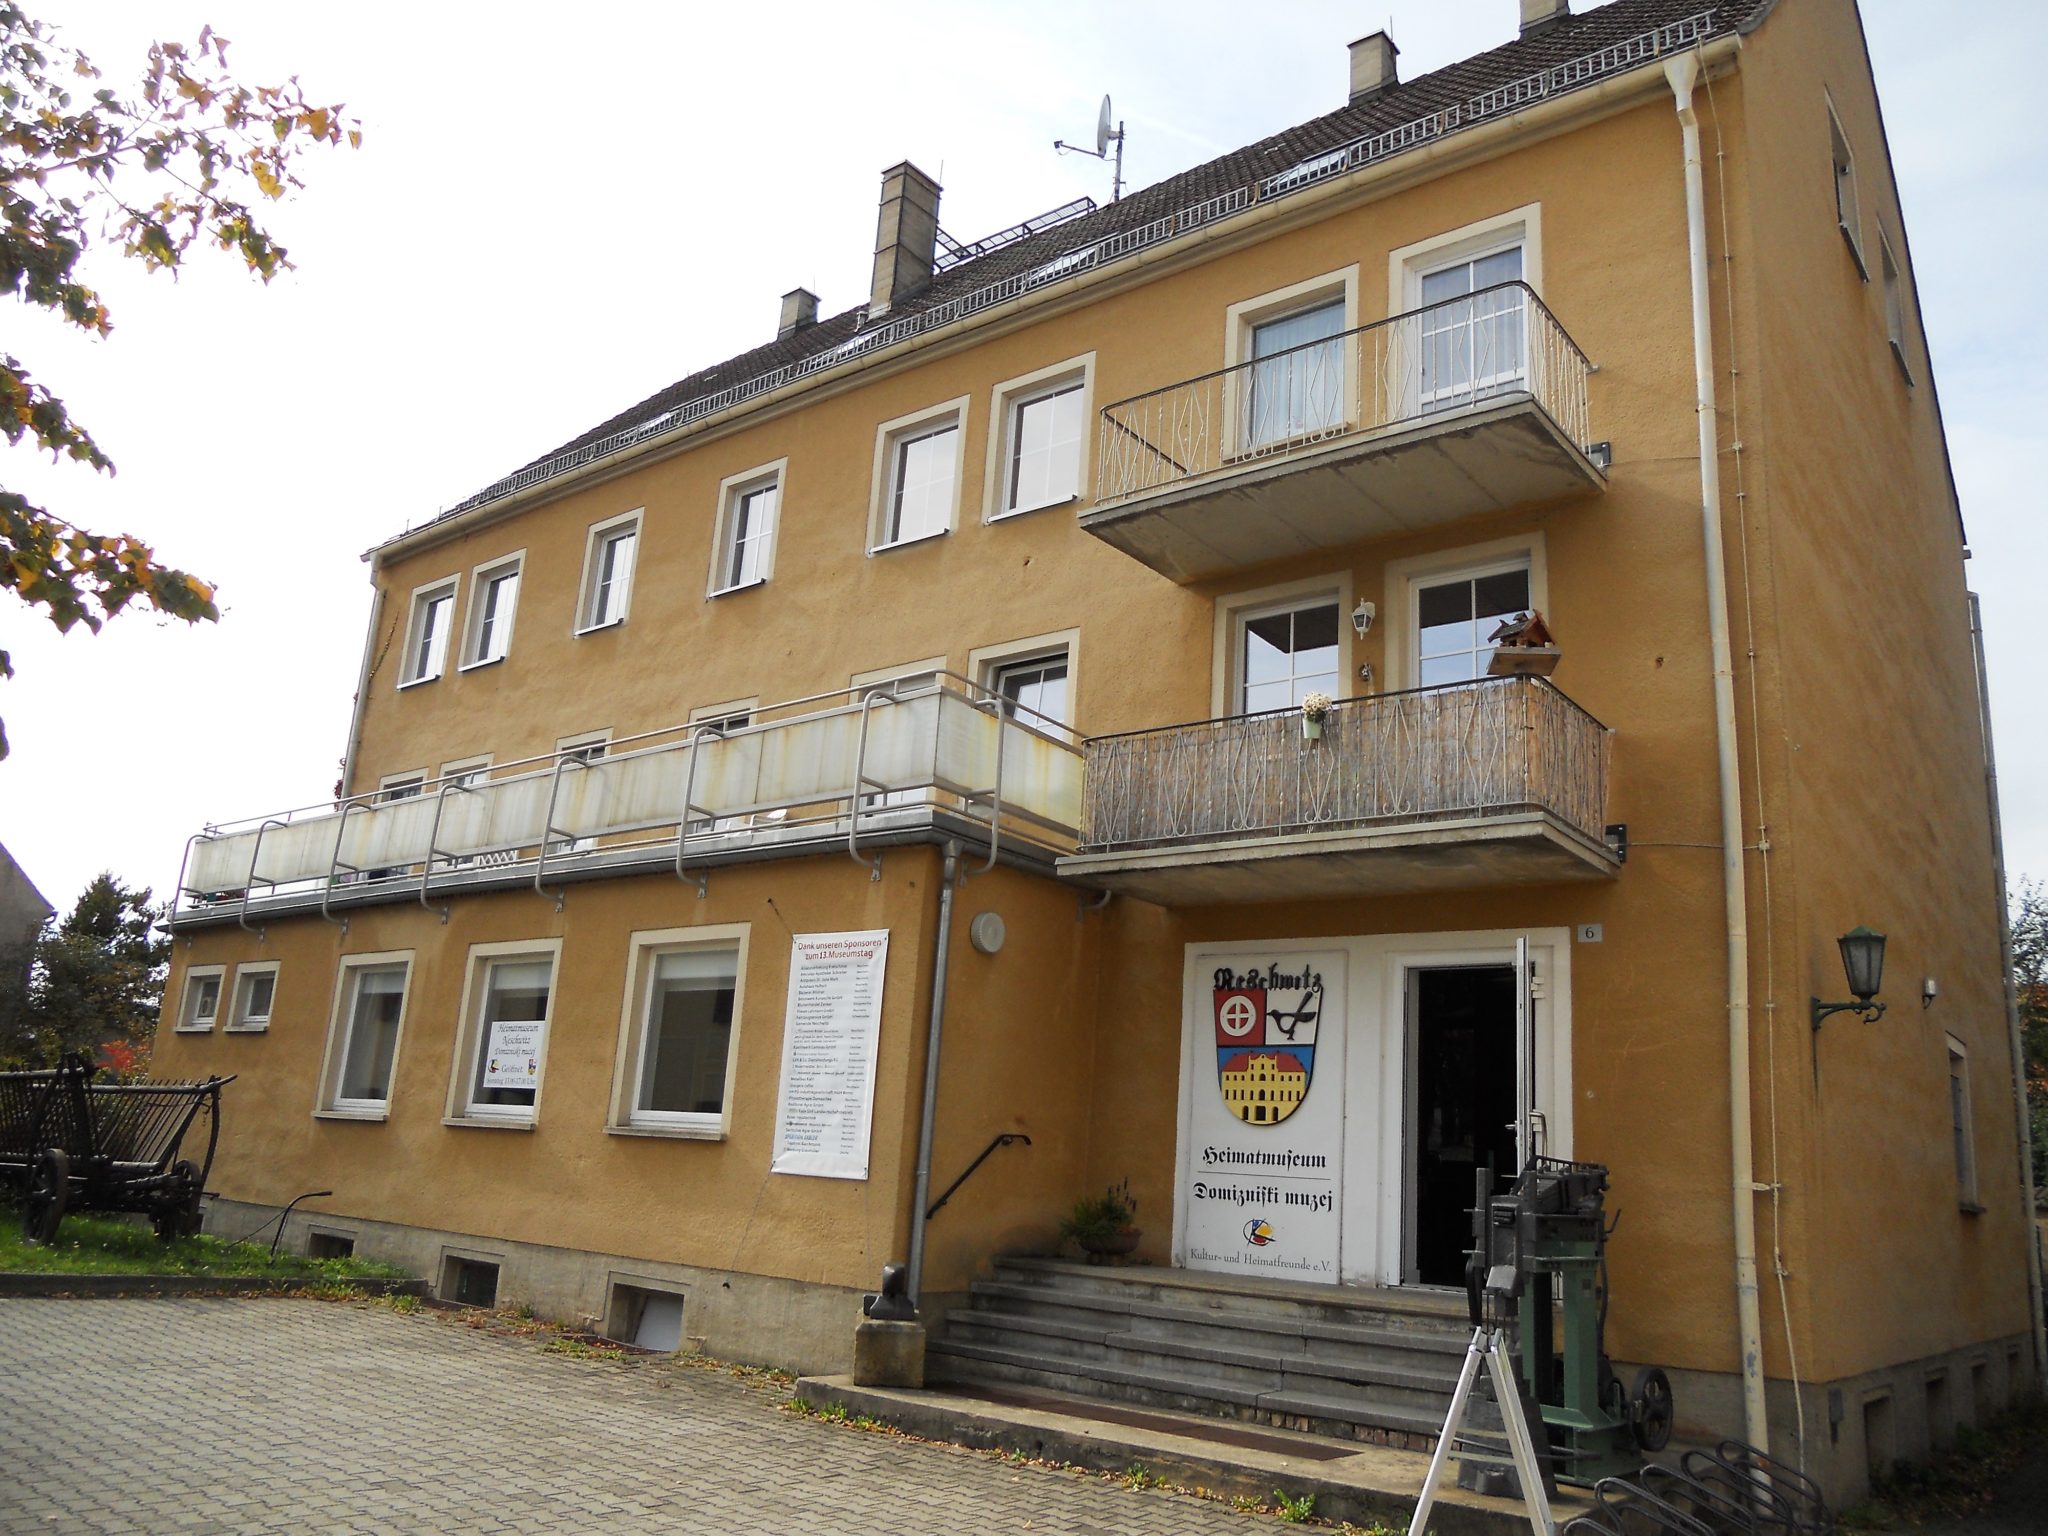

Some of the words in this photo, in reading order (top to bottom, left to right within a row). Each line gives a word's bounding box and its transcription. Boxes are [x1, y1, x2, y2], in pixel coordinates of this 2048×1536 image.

[1585, 926, 1594, 939] 6
[798, 942, 815, 951] Dank
[816, 941, 843, 950] unseren
[844, 939, 882, 949] Sponsoren
[805, 952, 819, 960] zum
[1285, 1190, 1333, 1212] muzej
[1190, 1248, 1223, 1261] Kultur-
[1224, 1251, 1240, 1264] und
[1244, 1254, 1311, 1270] Heimatfreunde
